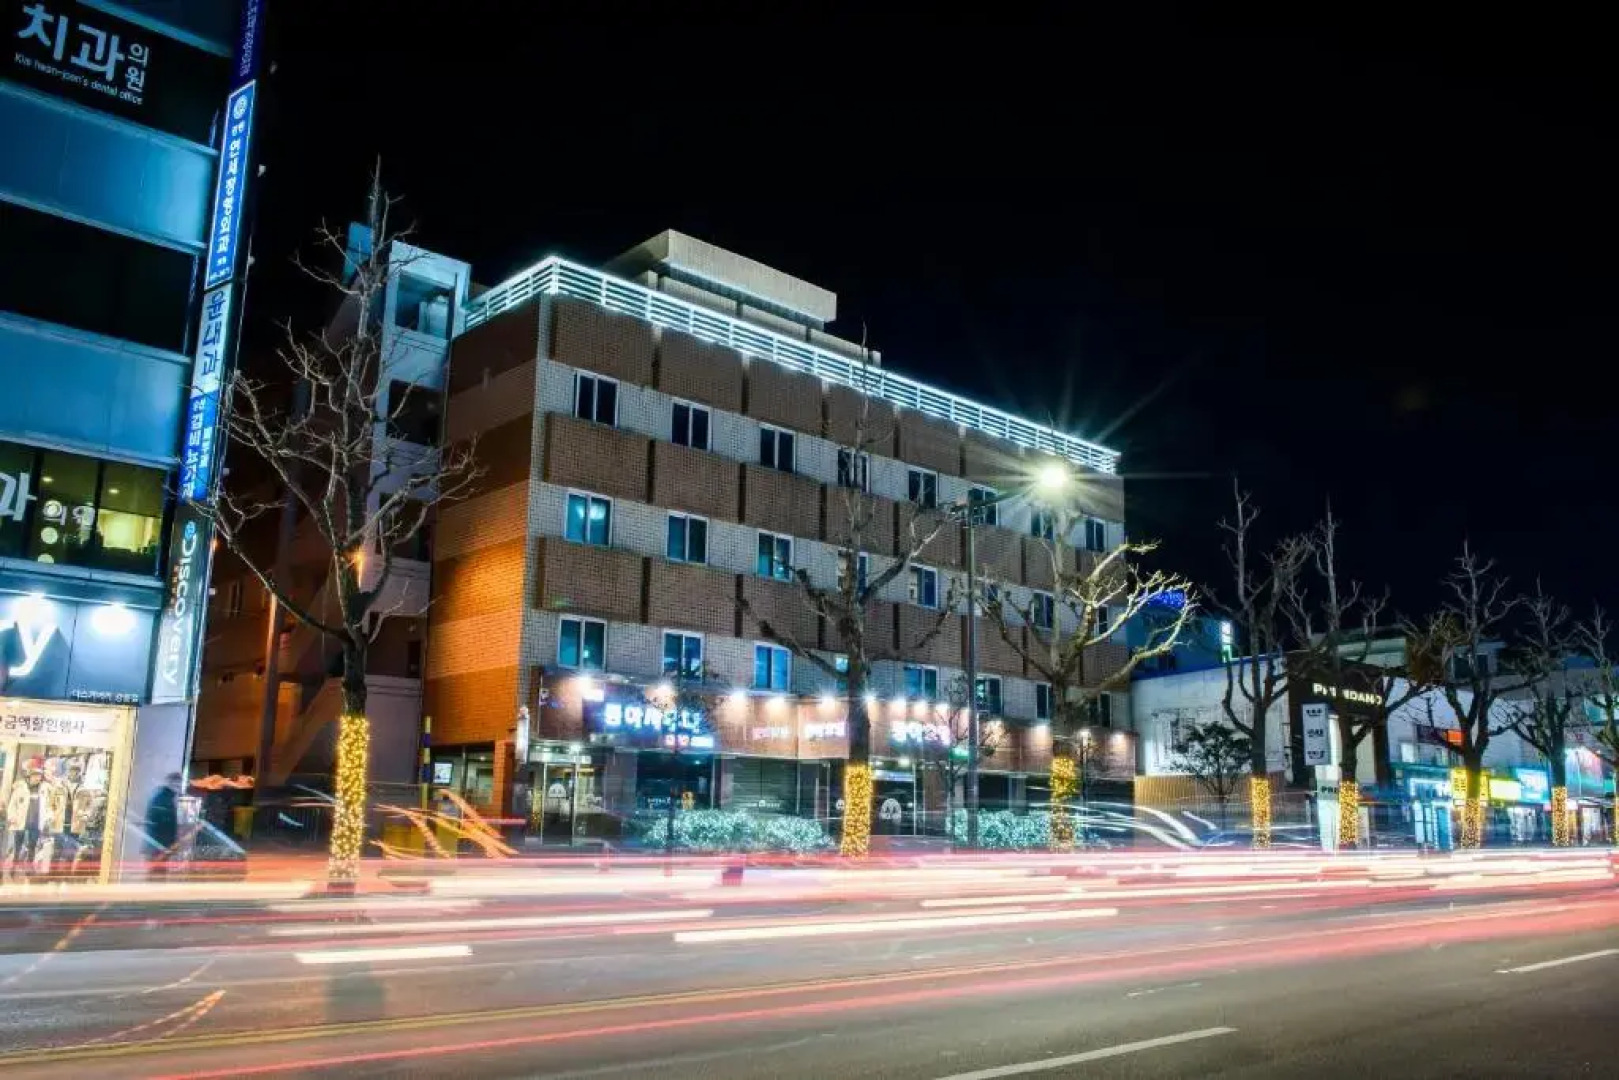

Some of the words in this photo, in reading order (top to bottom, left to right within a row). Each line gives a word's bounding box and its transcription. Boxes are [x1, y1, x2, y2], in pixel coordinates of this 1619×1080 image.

[18, 3, 125, 81] 치과
[125, 43, 149, 92] 의원
[119, 90, 143, 105] office
[158, 533, 197, 684] Discovery
[0, 612, 57, 676] y
[0, 715, 84, 733] 금액할인행사
